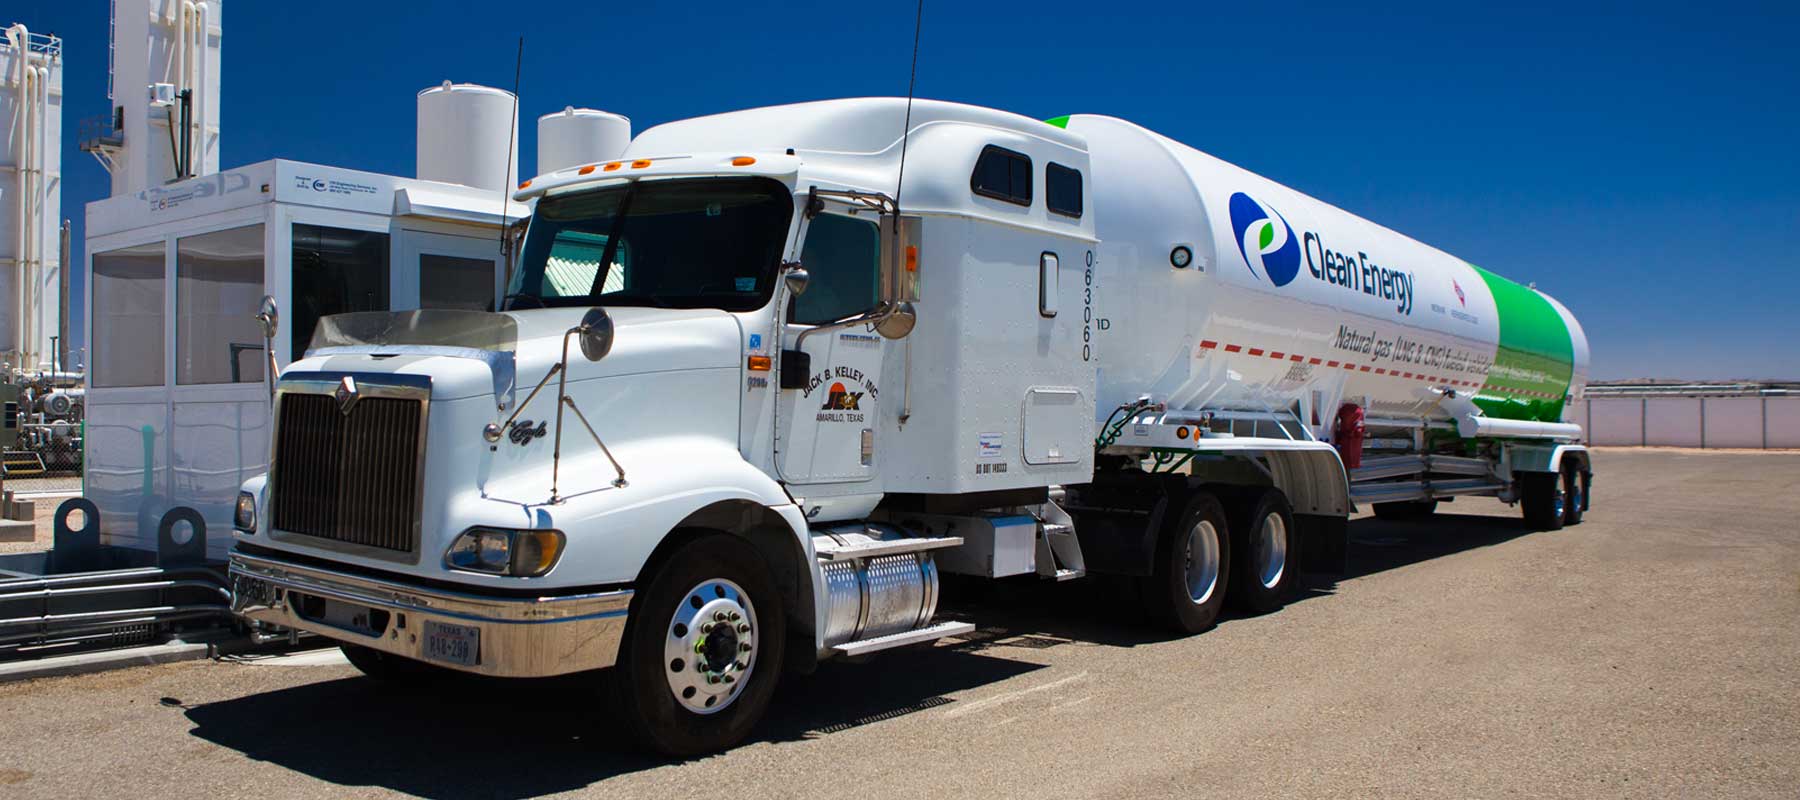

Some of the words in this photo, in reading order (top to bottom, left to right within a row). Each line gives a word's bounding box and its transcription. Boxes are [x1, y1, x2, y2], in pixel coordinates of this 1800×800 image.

[1303, 231, 1359, 291] Clean
[1358, 251, 1413, 316] Energy
[1083, 249, 1093, 362] 063060
[1334, 325, 1376, 354] Natural
[1371, 339, 1393, 362] gas
[1392, 336, 1416, 362] (LNG
[1414, 344, 1424, 364] &
[802, 373, 823, 399] JACK
[824, 368, 833, 381] B.
[835, 366, 864, 386] KELLEY,
[865, 379, 879, 402] INC.
[816, 413, 845, 424] AMARILLO,
[846, 413, 864, 423] TEXAS
